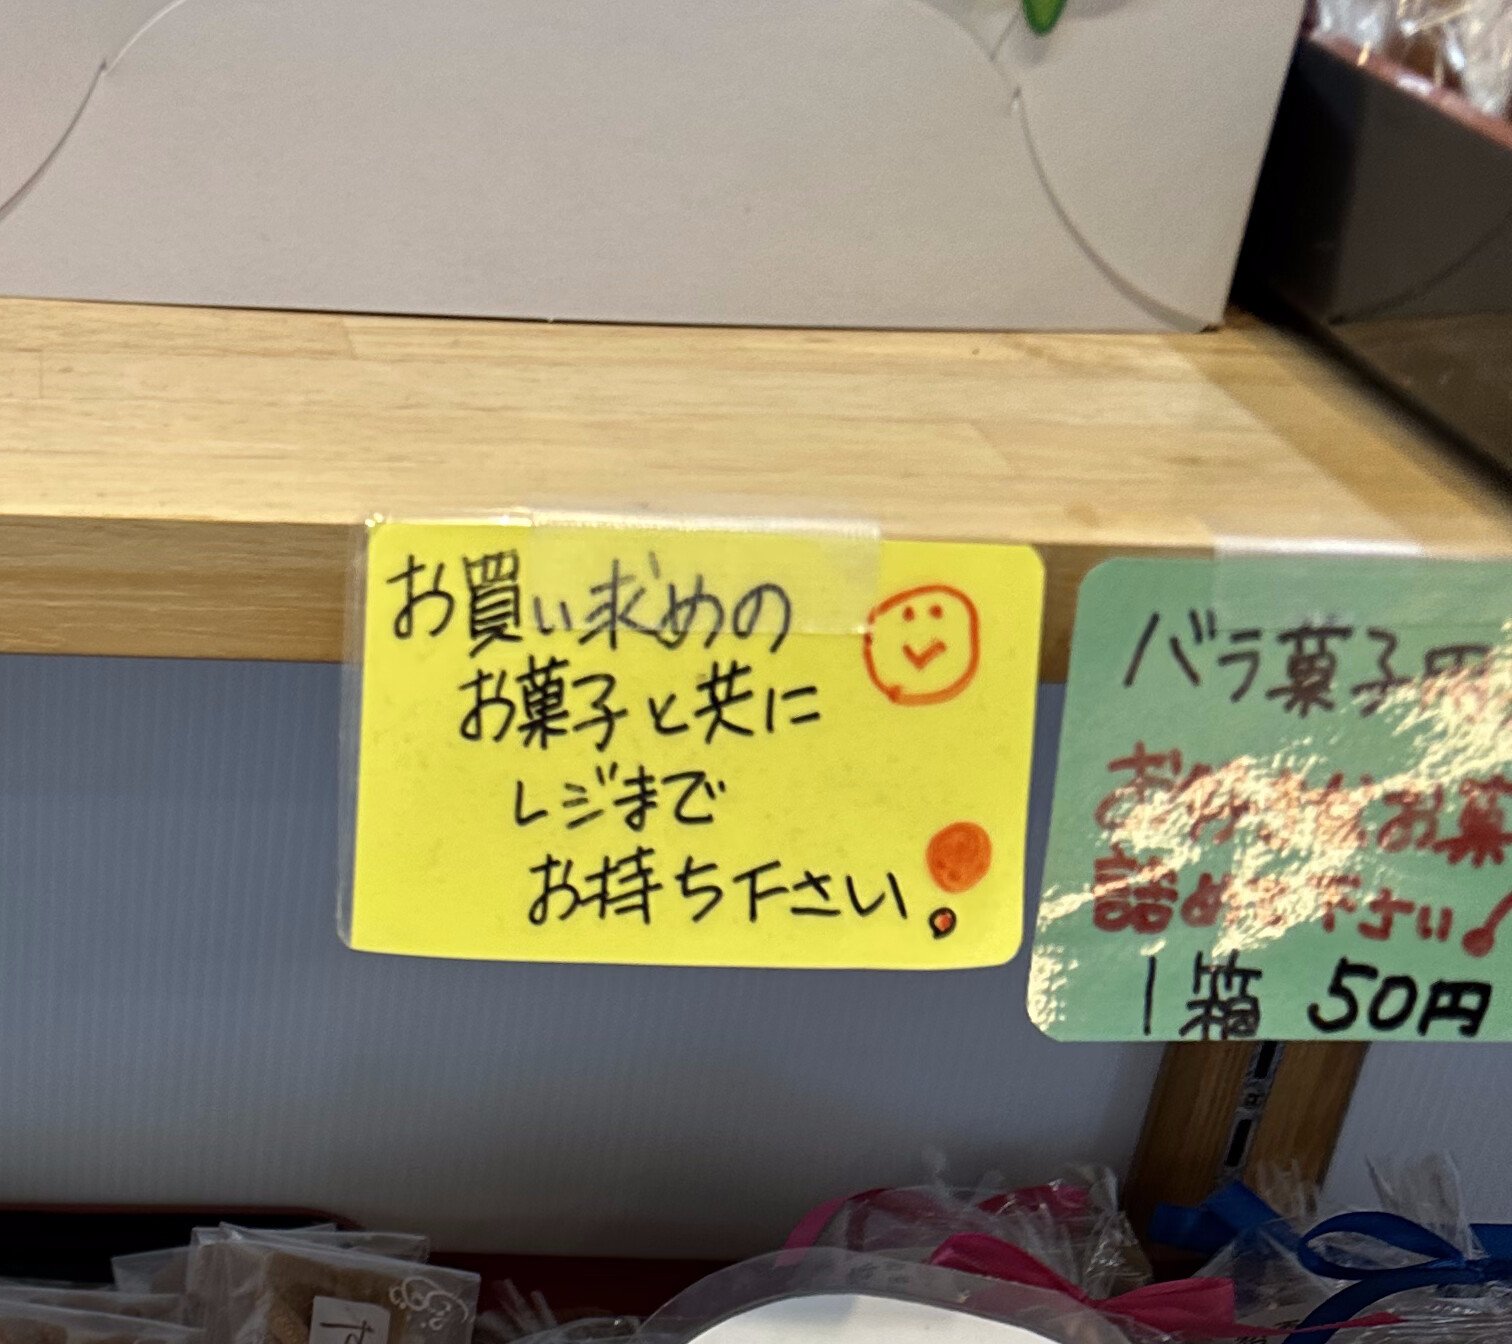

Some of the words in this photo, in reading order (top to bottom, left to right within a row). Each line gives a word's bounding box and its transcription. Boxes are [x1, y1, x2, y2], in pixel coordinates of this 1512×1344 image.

[387, 550, 792, 656] お買い求めの
[458, 656, 821, 751] お菓子と共に
[514, 762, 726, 830] レジまで
[1307, 955, 1493, 1038] 50円
